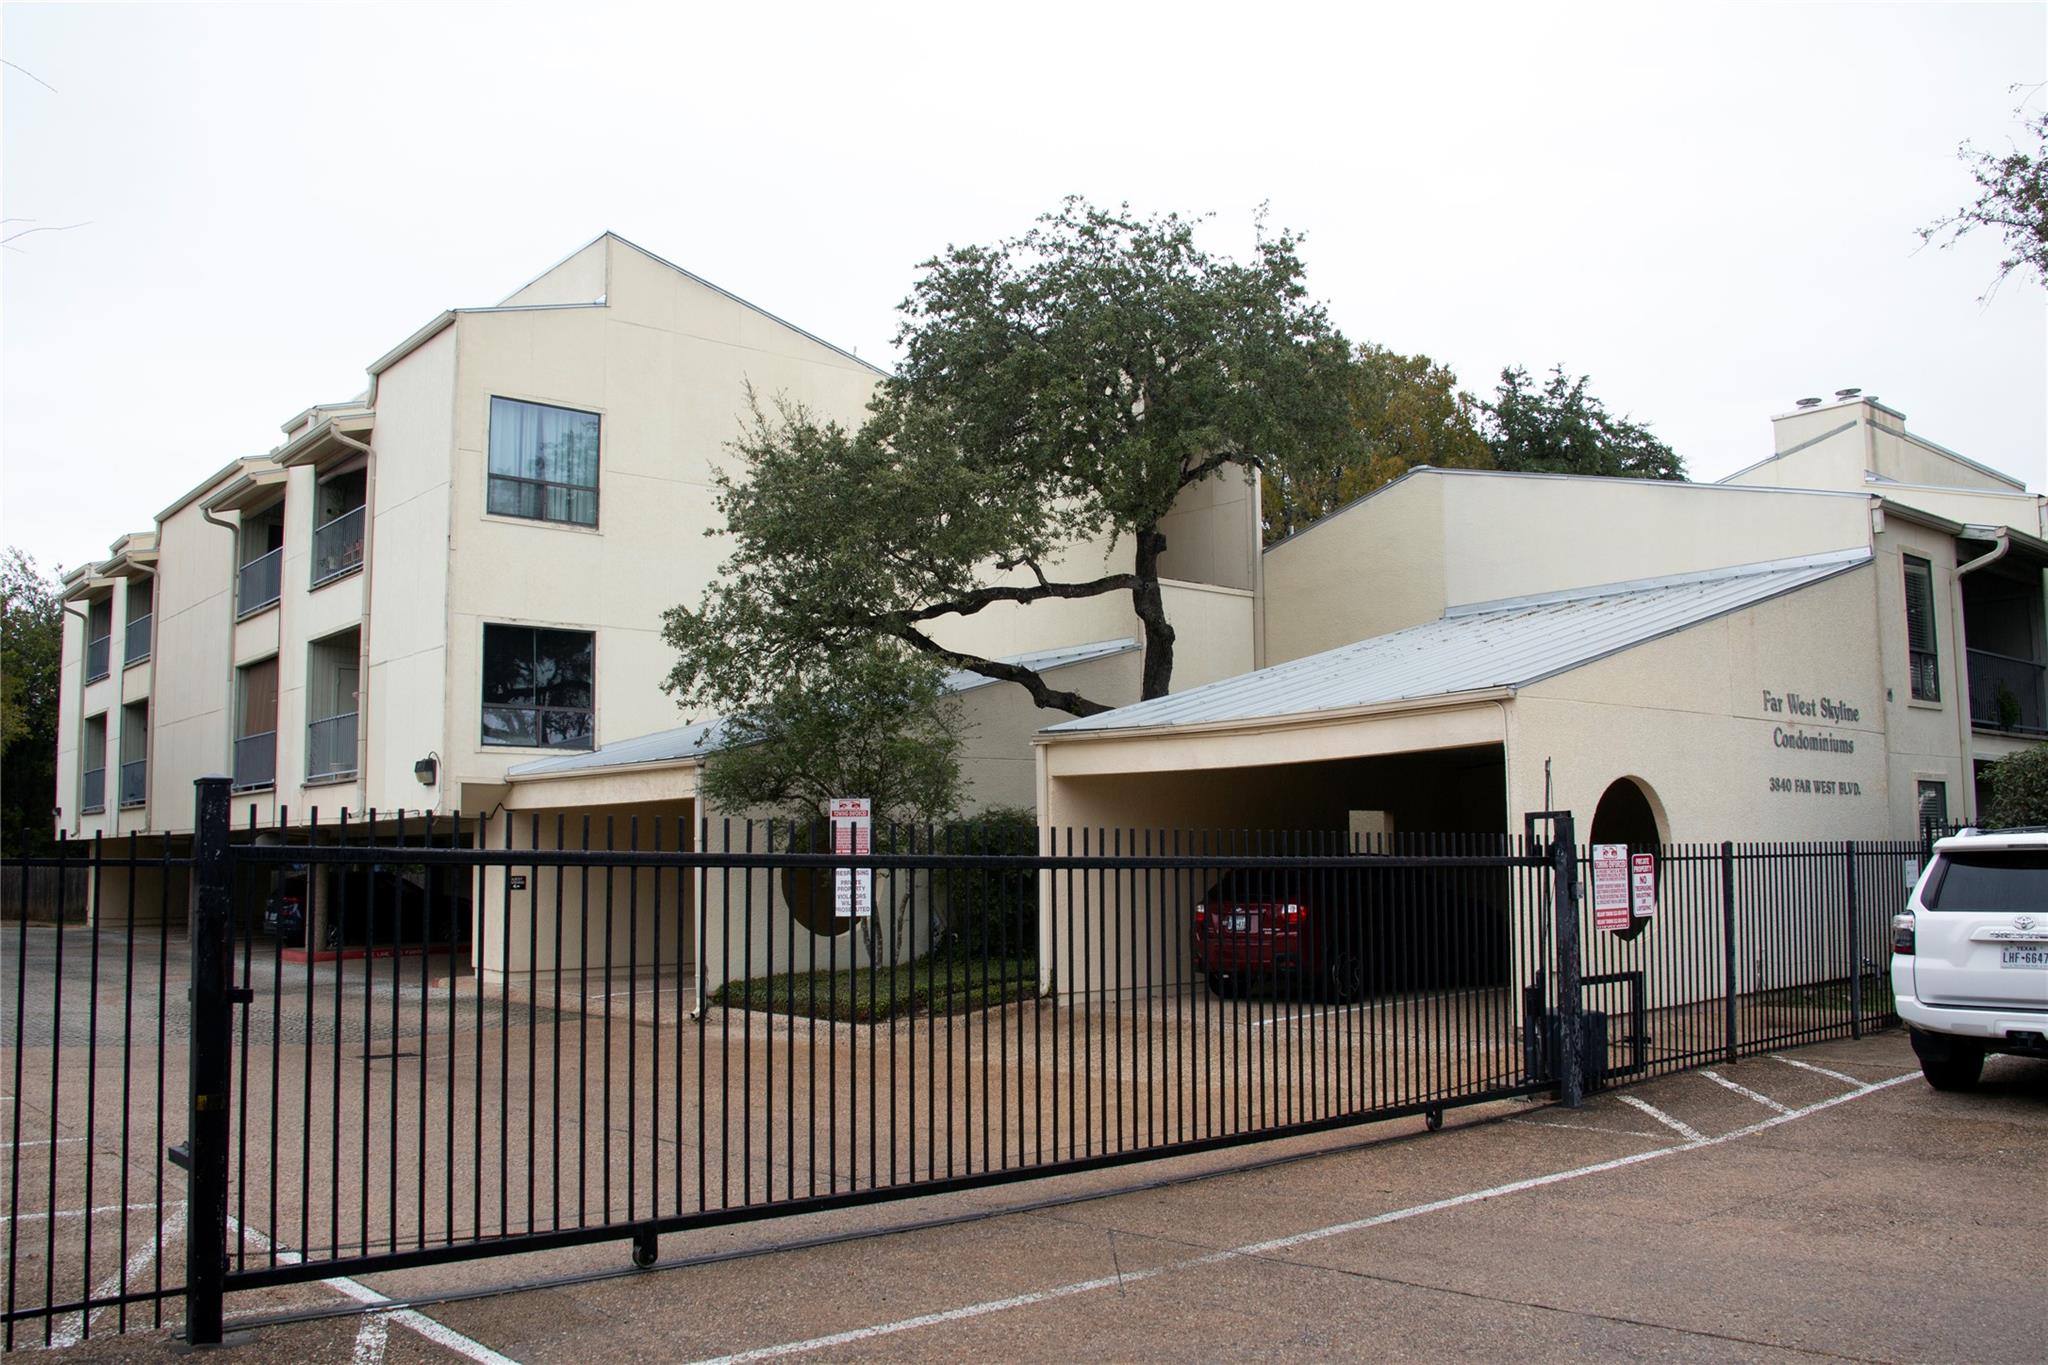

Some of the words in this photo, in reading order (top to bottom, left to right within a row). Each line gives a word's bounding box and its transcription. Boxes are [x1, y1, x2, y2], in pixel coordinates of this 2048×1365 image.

[1762, 689, 1782, 712] Far
[1786, 693, 1816, 717] West
[1820, 697, 1859, 724] Skyline
[1773, 726, 1854, 754] Condominiums
[1769, 777, 1791, 792] 3840
[1794, 779, 1811, 792] FAR
[1812, 780, 1836, 794] WEST
[1838, 781, 1861, 795] BLVD.
[1640, 875, 1647, 884] NO
